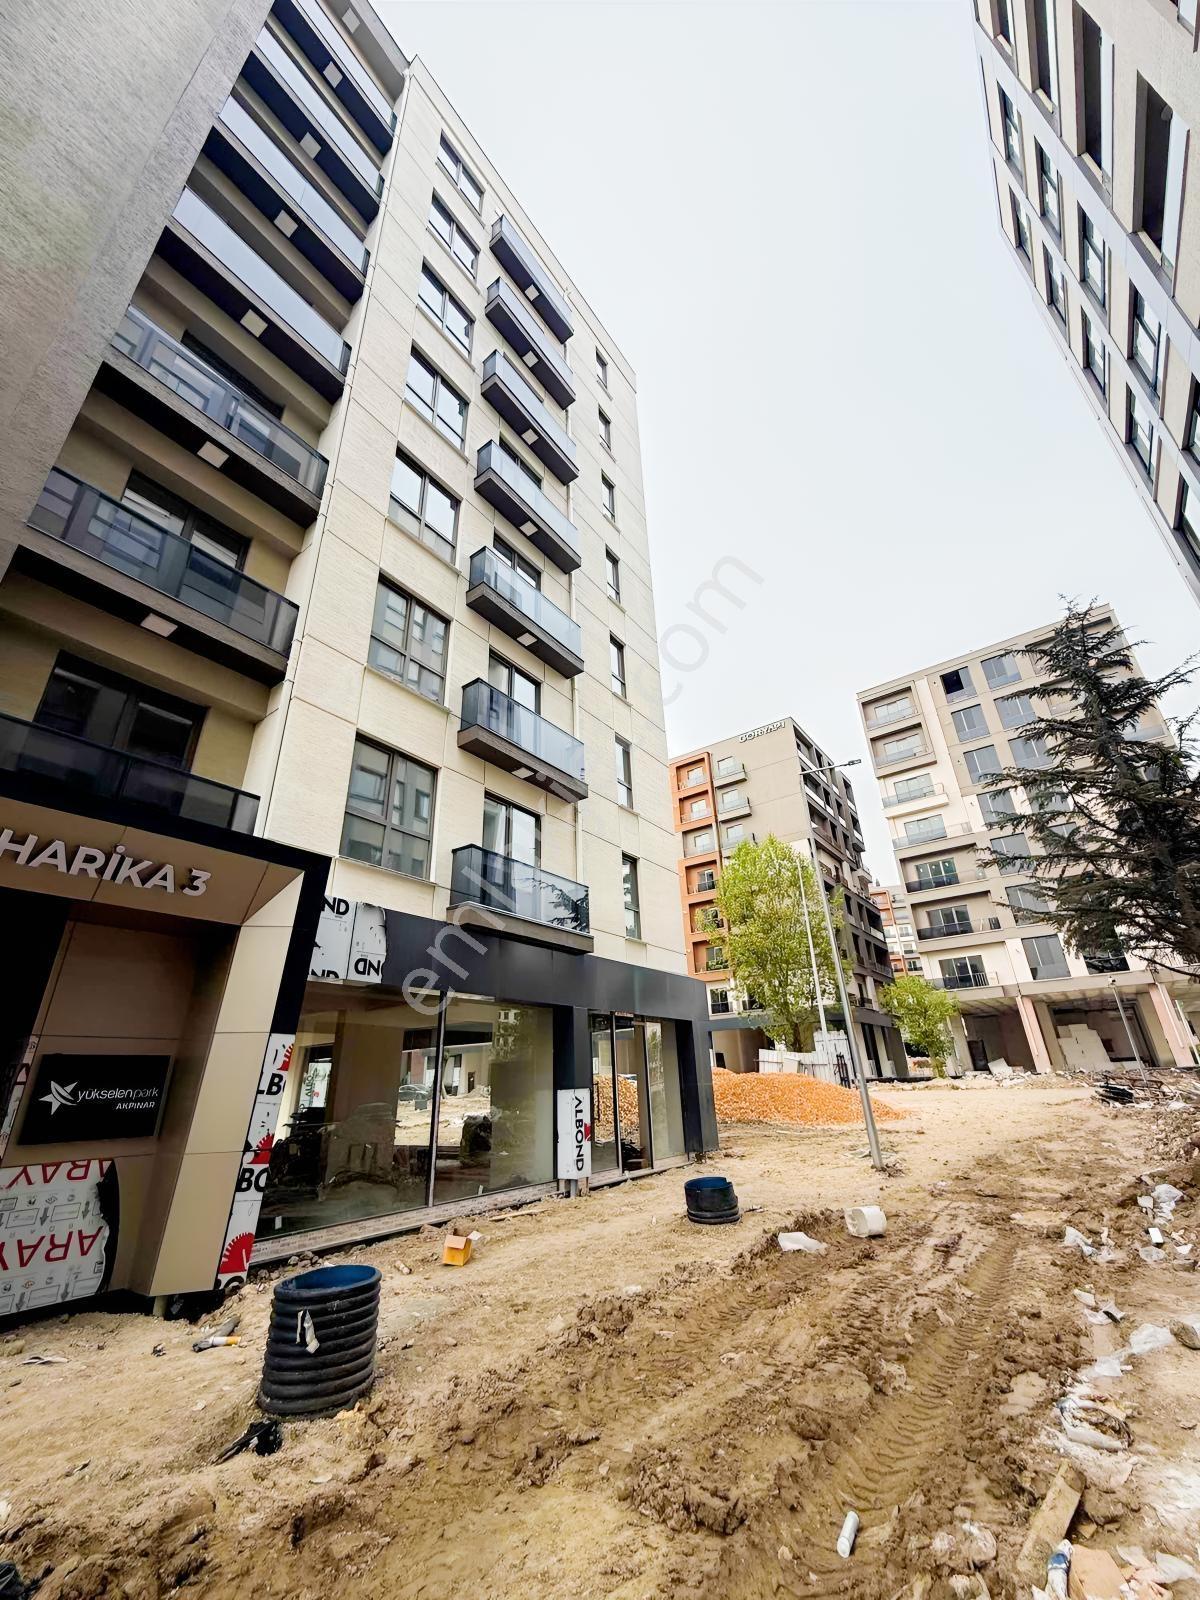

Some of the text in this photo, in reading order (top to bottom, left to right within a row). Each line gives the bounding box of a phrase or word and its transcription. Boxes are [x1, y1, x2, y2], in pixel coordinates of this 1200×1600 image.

[0, 828, 212, 897] HARİKA 3
[574, 1095, 585, 1172] ALBOND
